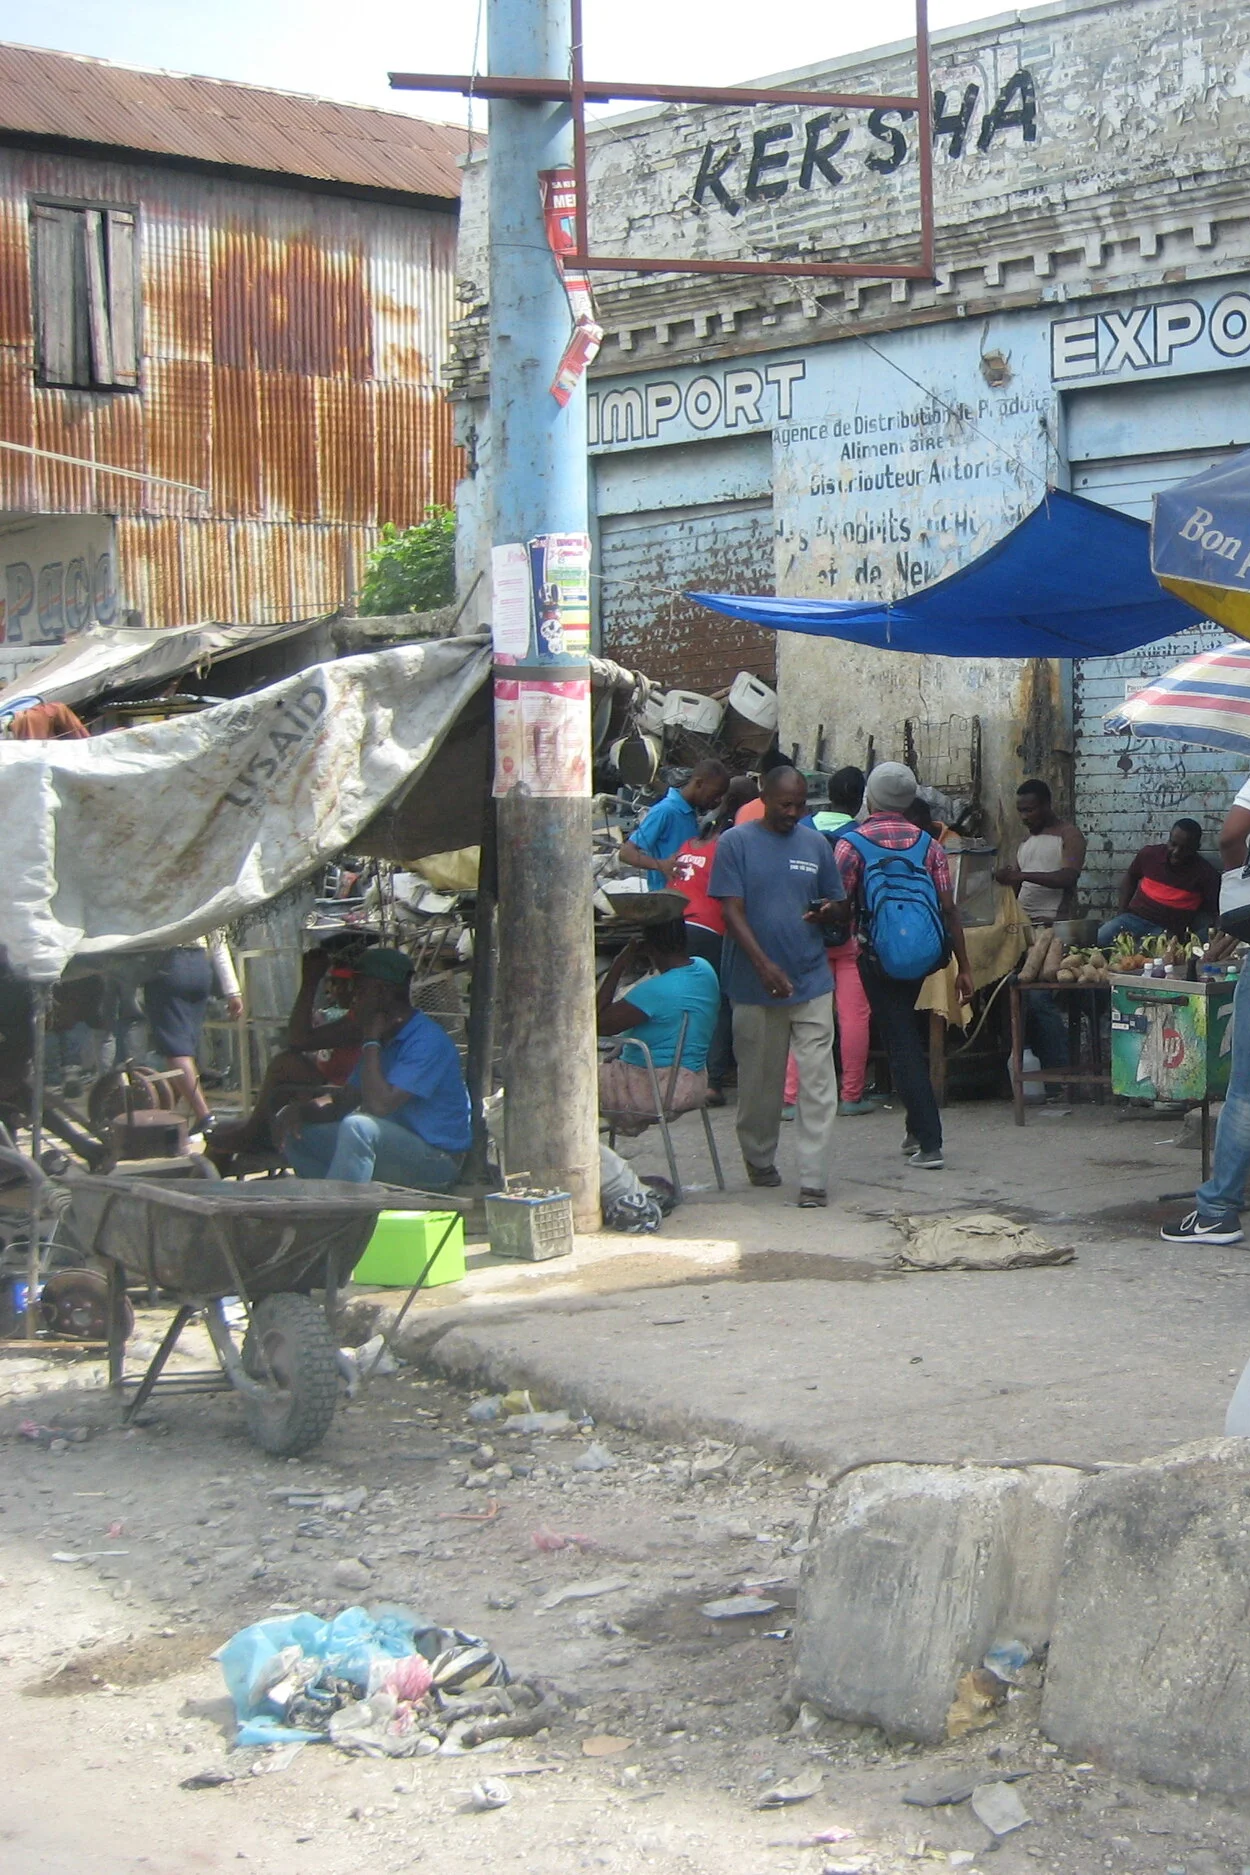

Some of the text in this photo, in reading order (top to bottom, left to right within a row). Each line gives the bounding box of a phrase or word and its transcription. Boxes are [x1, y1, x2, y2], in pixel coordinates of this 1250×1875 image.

[691, 70, 1036, 217] KERSHA
[553, 194, 577, 209] ME
[586, 358, 806, 446] IMPORT
[772, 423, 828, 447] Agence
[833, 419, 851, 438] de
[1178, 506, 1243, 561] Bon
